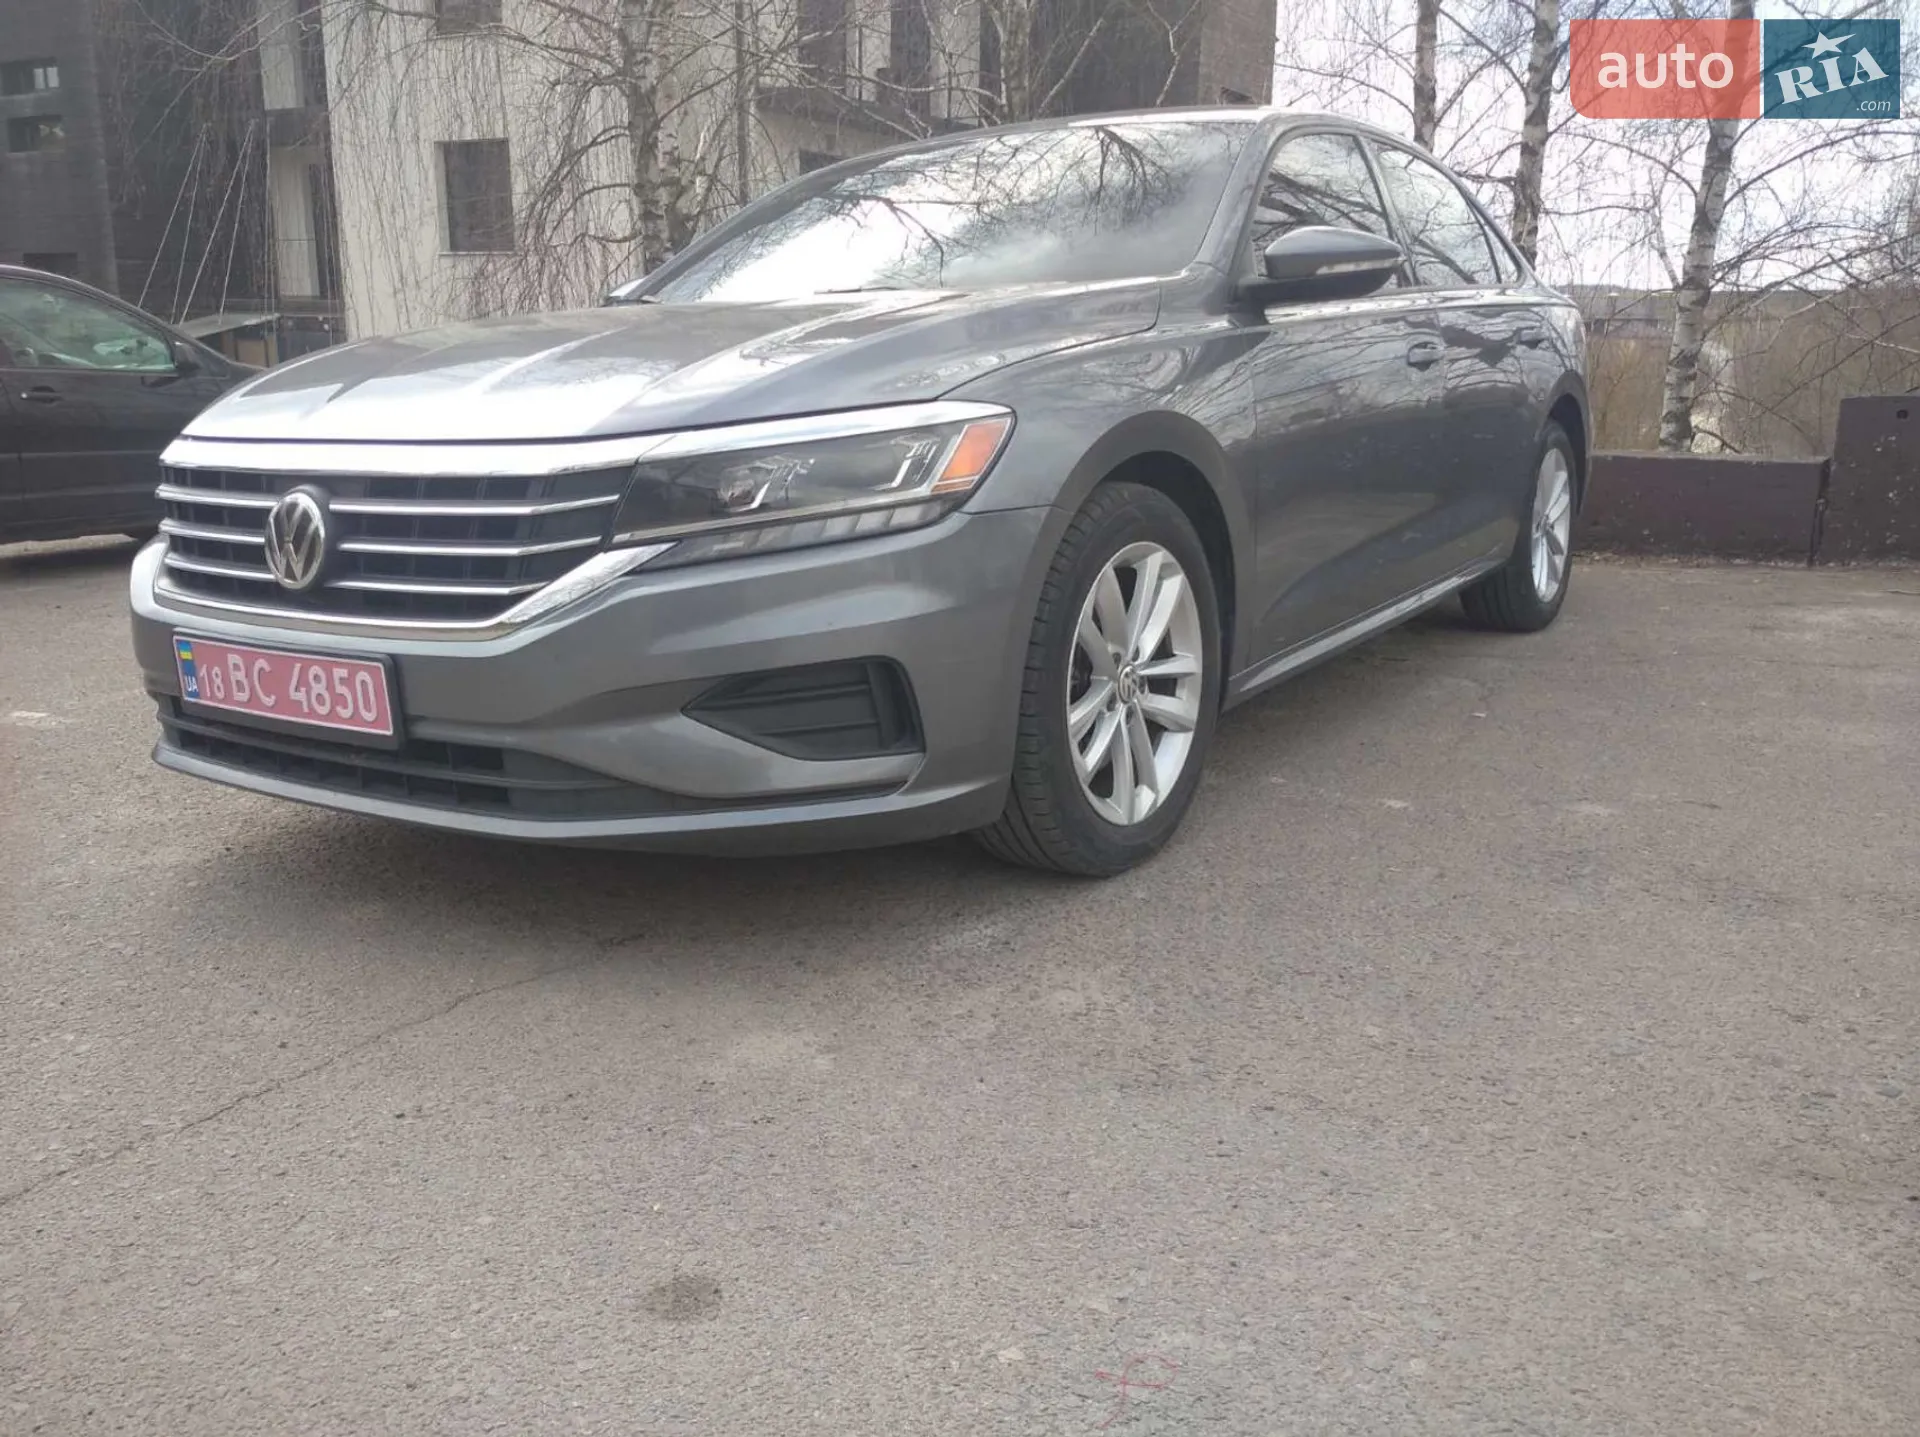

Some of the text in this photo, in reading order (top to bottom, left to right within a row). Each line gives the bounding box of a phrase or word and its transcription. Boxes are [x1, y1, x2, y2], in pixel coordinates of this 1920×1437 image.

[184, 675, 199, 693] UA
[200, 653, 377, 722] 18 BC 4850
